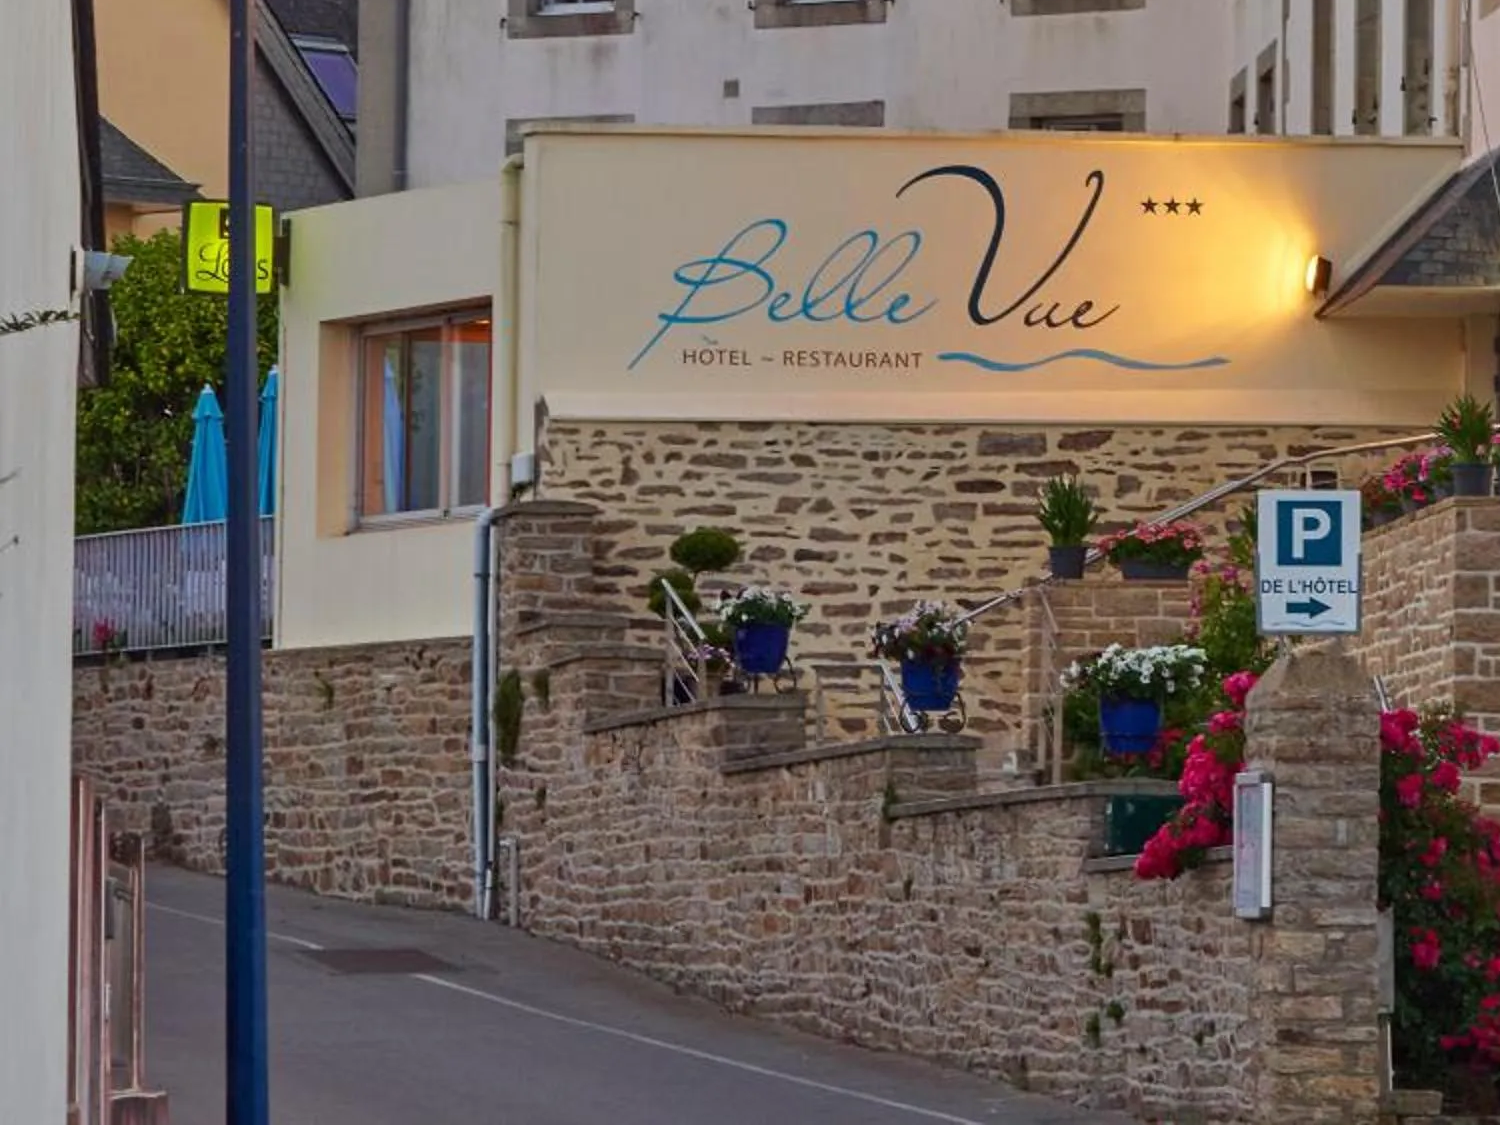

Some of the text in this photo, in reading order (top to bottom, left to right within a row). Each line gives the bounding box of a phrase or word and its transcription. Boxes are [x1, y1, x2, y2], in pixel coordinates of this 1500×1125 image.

[626, 165, 1121, 370] Belle Vue
[783, 350, 923, 369] RESTAURANT
[1291, 508, 1332, 560] P
[1261, 576, 1360, 594] DE L'HÔTEL
